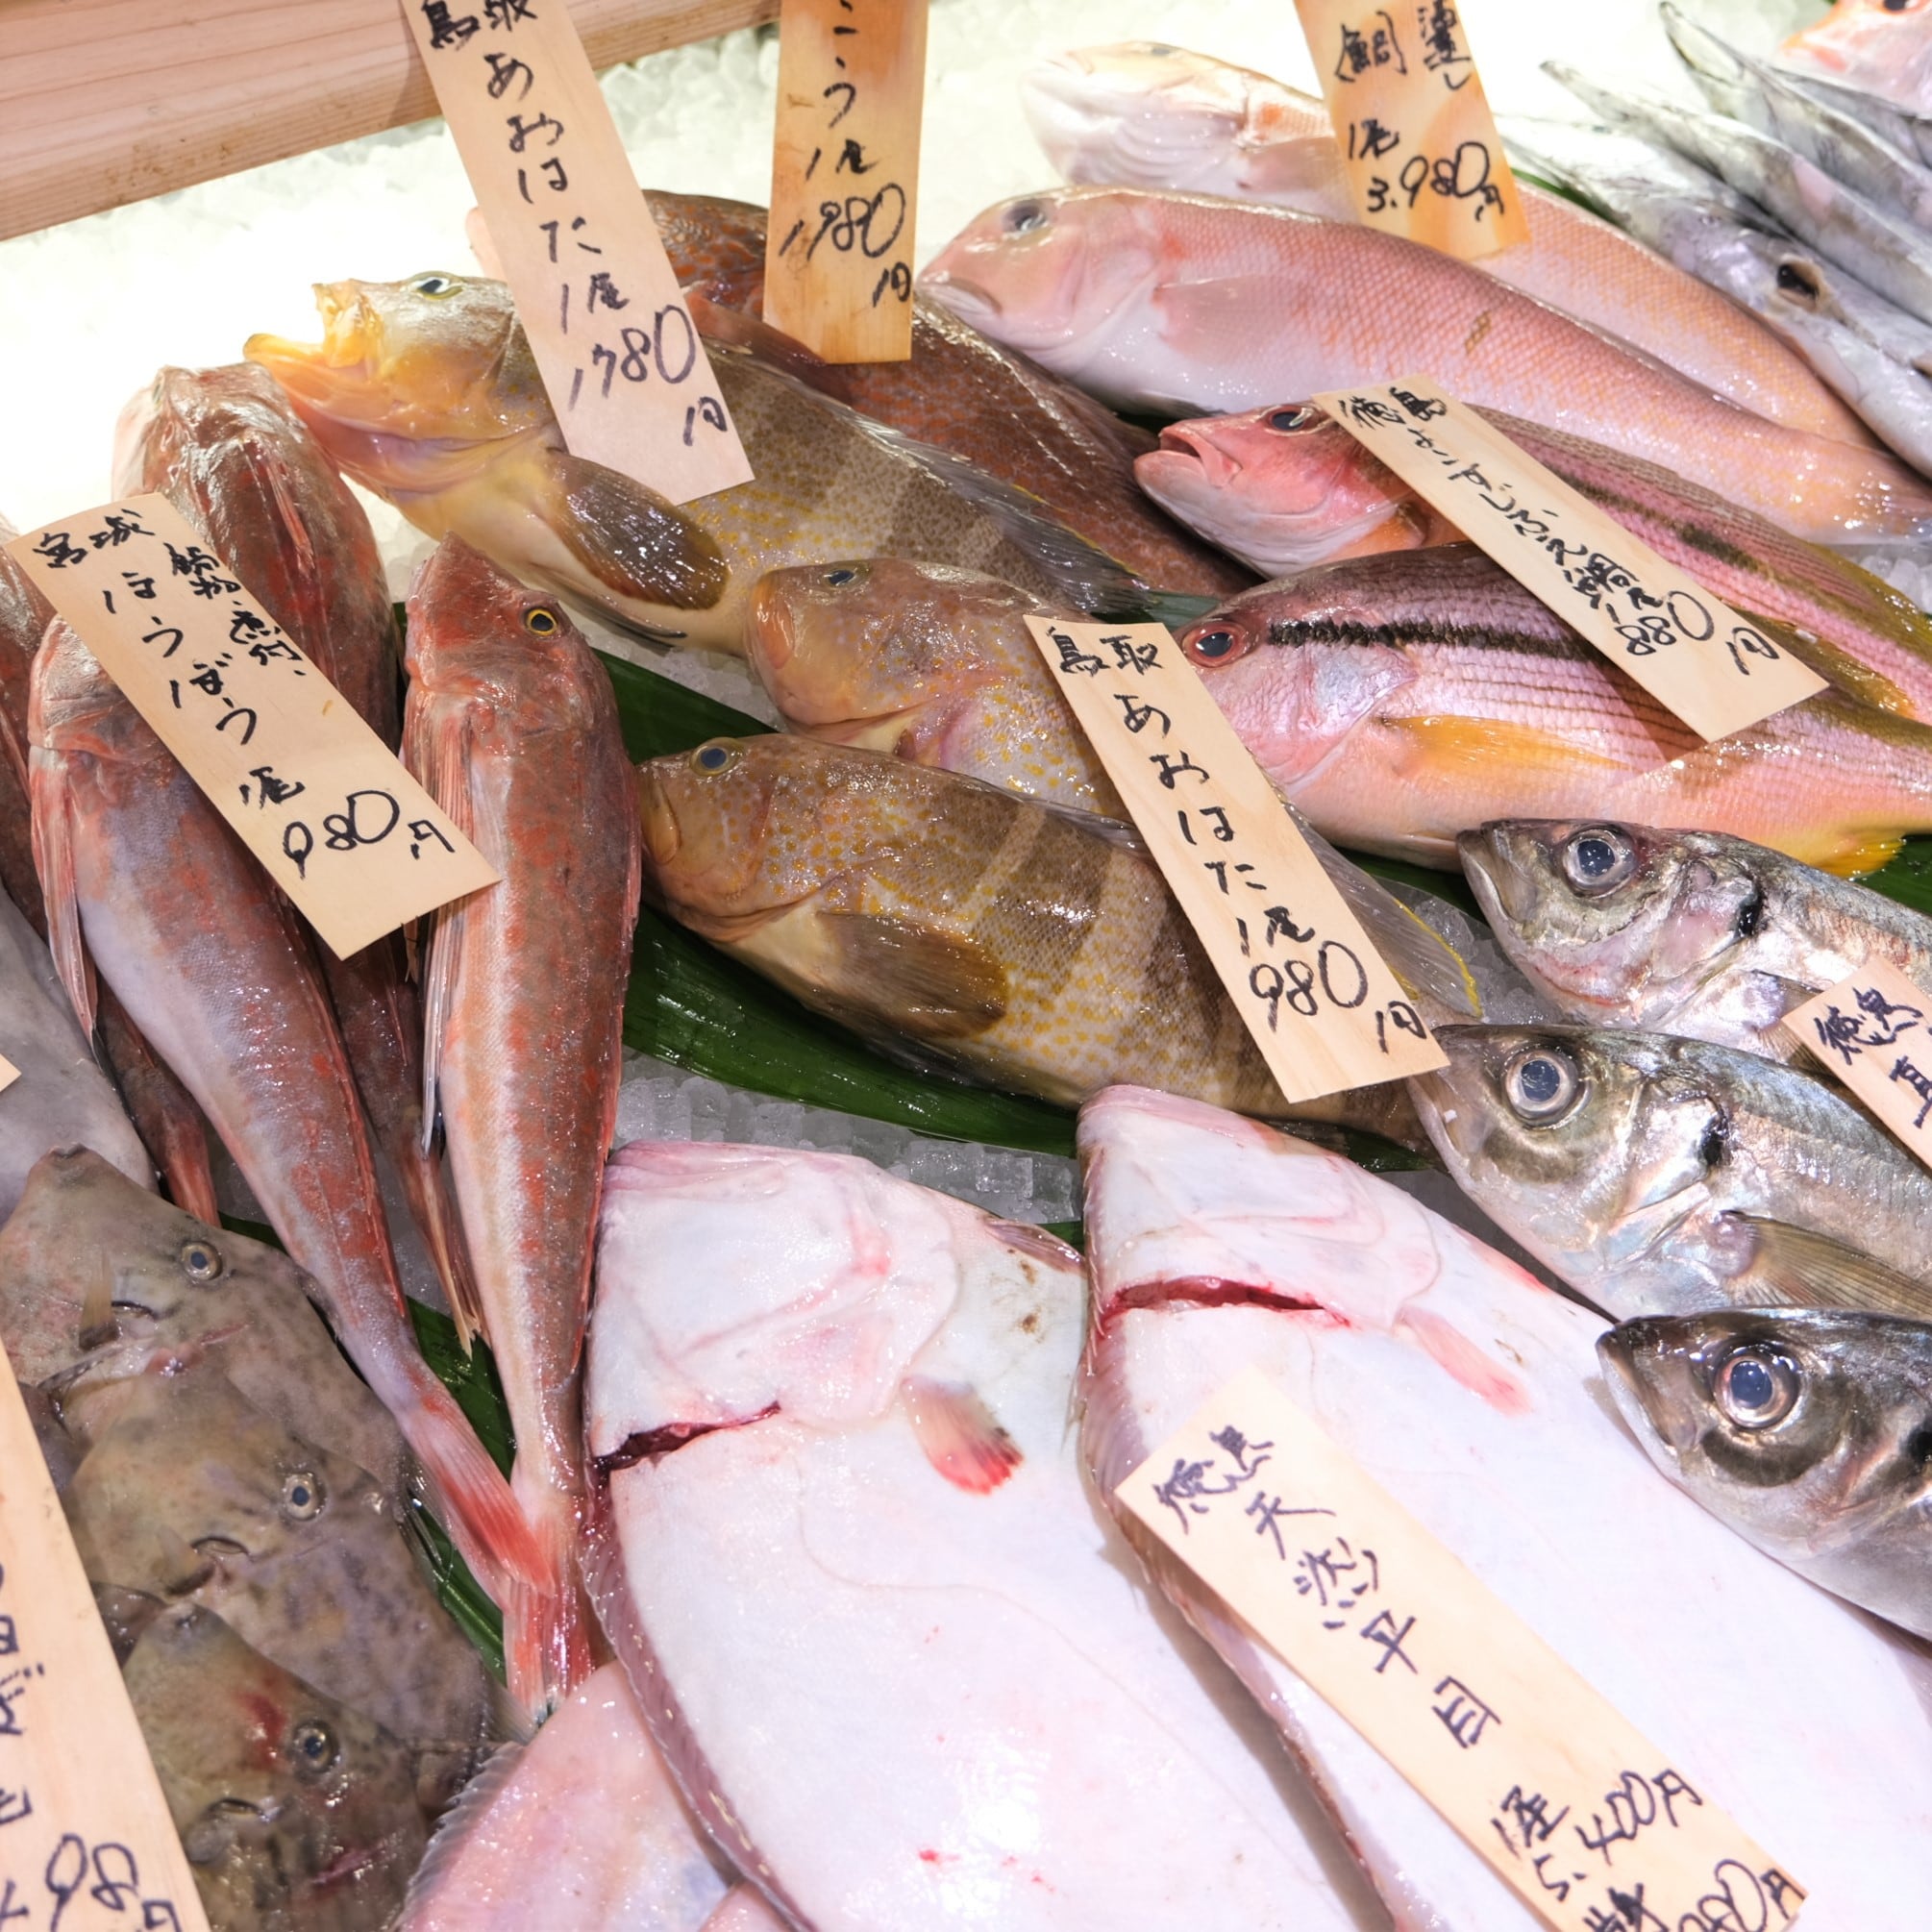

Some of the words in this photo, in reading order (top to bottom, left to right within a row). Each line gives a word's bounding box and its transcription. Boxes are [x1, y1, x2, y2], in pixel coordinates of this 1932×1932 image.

[1337, 386, 1448, 431] 徳島
[33, 508, 155, 569] 宮城
[102, 571, 258, 746] ほうぼう
[1046, 626, 1164, 677] 鳥取
[1113, 693, 1267, 895] あおはた
